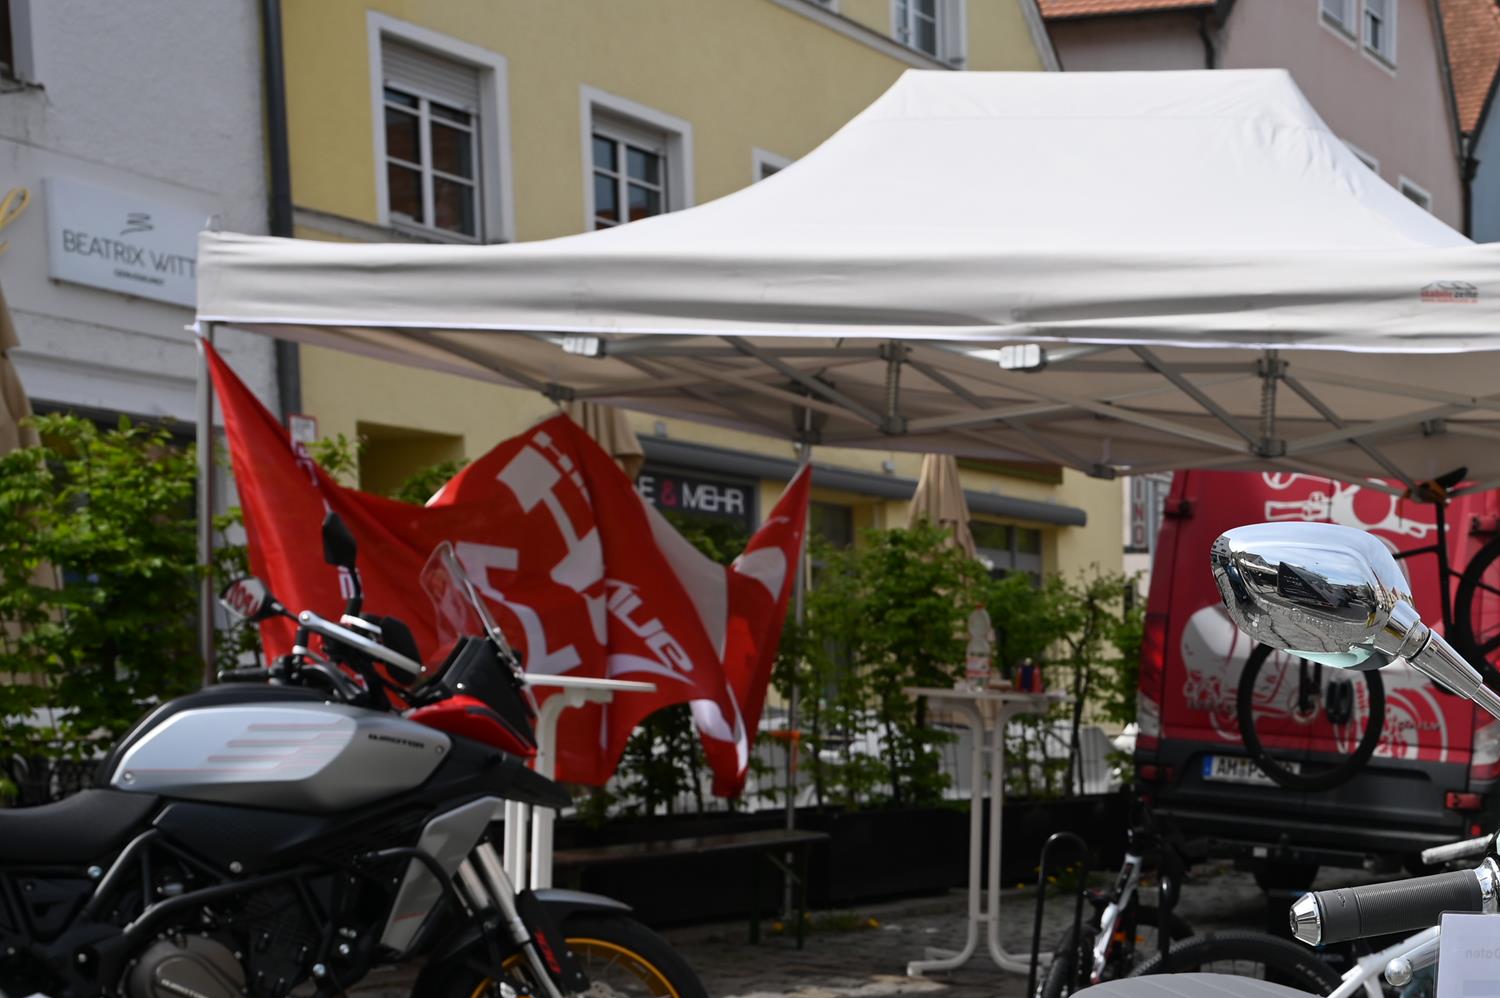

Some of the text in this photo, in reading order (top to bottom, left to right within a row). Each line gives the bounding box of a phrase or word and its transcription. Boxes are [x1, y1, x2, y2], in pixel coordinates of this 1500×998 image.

[62, 229, 146, 267] BEATRIX
[661, 479, 678, 507] &
[682, 482, 745, 515] MEHR
[1215, 756, 1239, 776] AM
